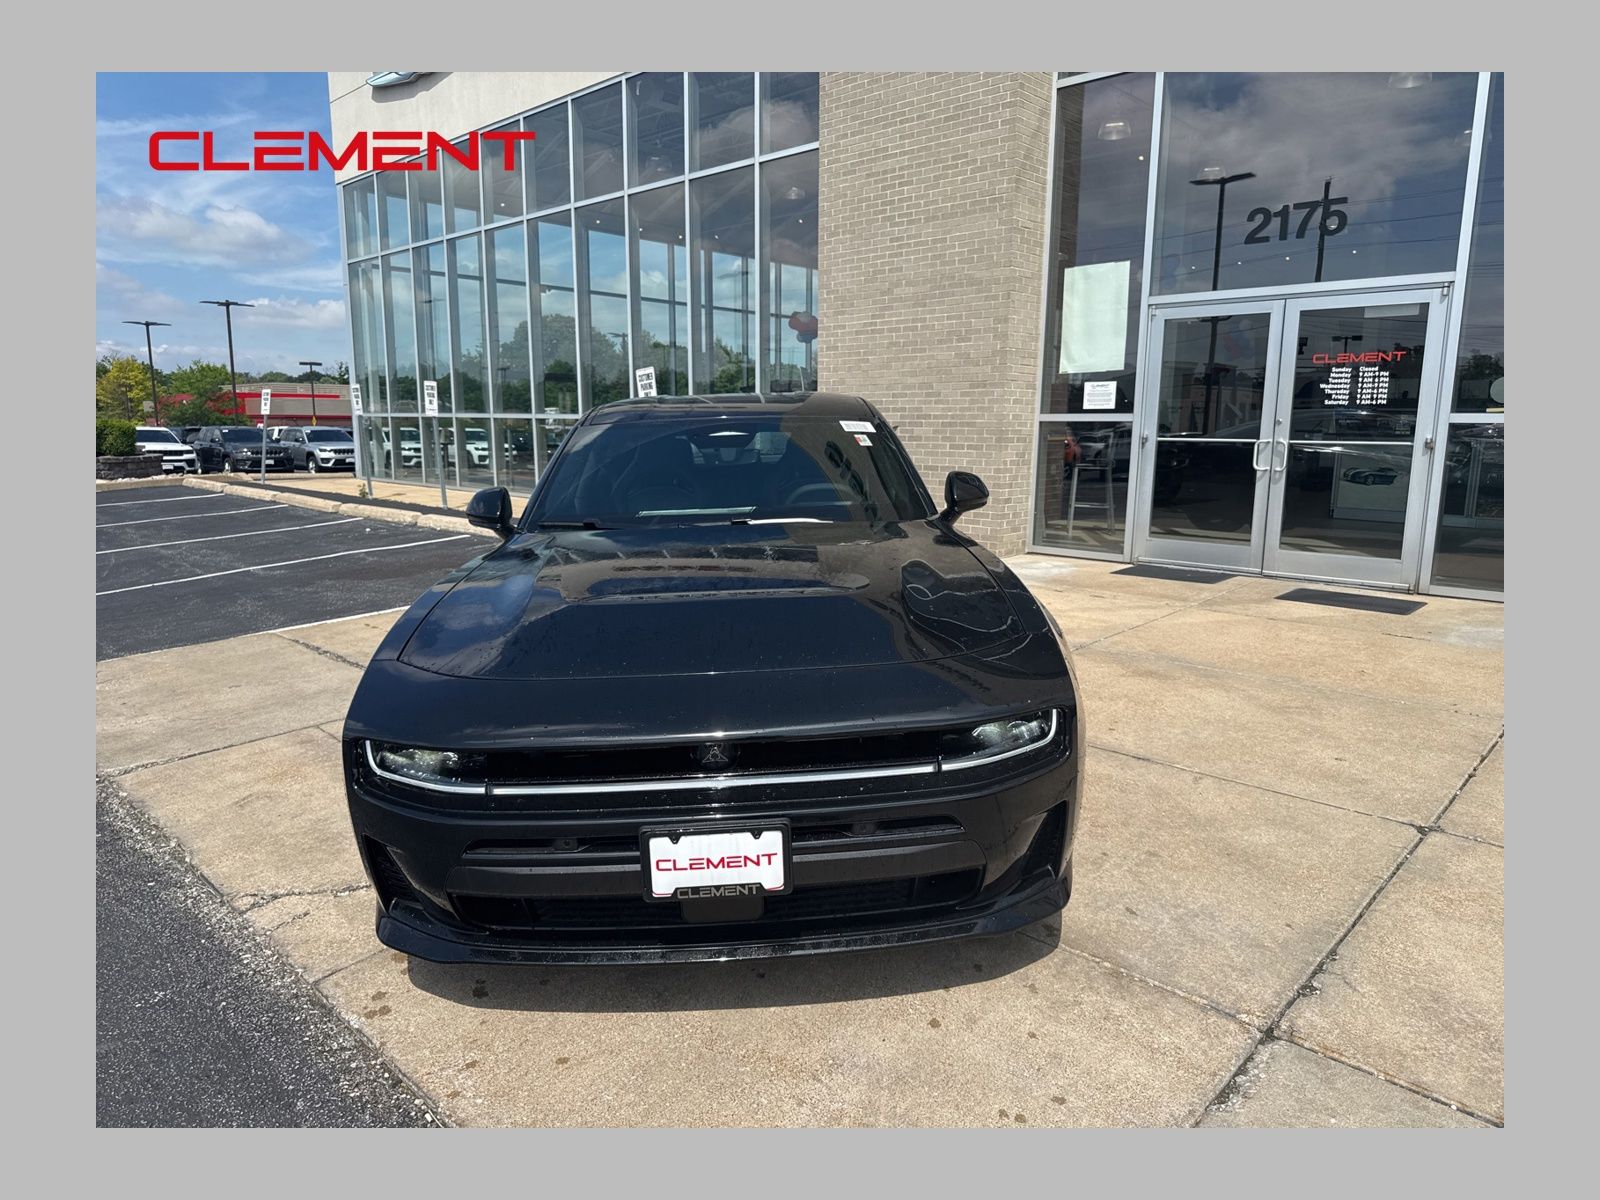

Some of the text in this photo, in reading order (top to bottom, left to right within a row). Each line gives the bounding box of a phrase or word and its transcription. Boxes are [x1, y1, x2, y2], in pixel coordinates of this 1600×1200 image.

[1244, 197, 1348, 244] 2175
[1312, 352, 1406, 364] CLEMENT
[656, 852, 778, 872] CLEMENT
[677, 884, 761, 899] CLEMENT
